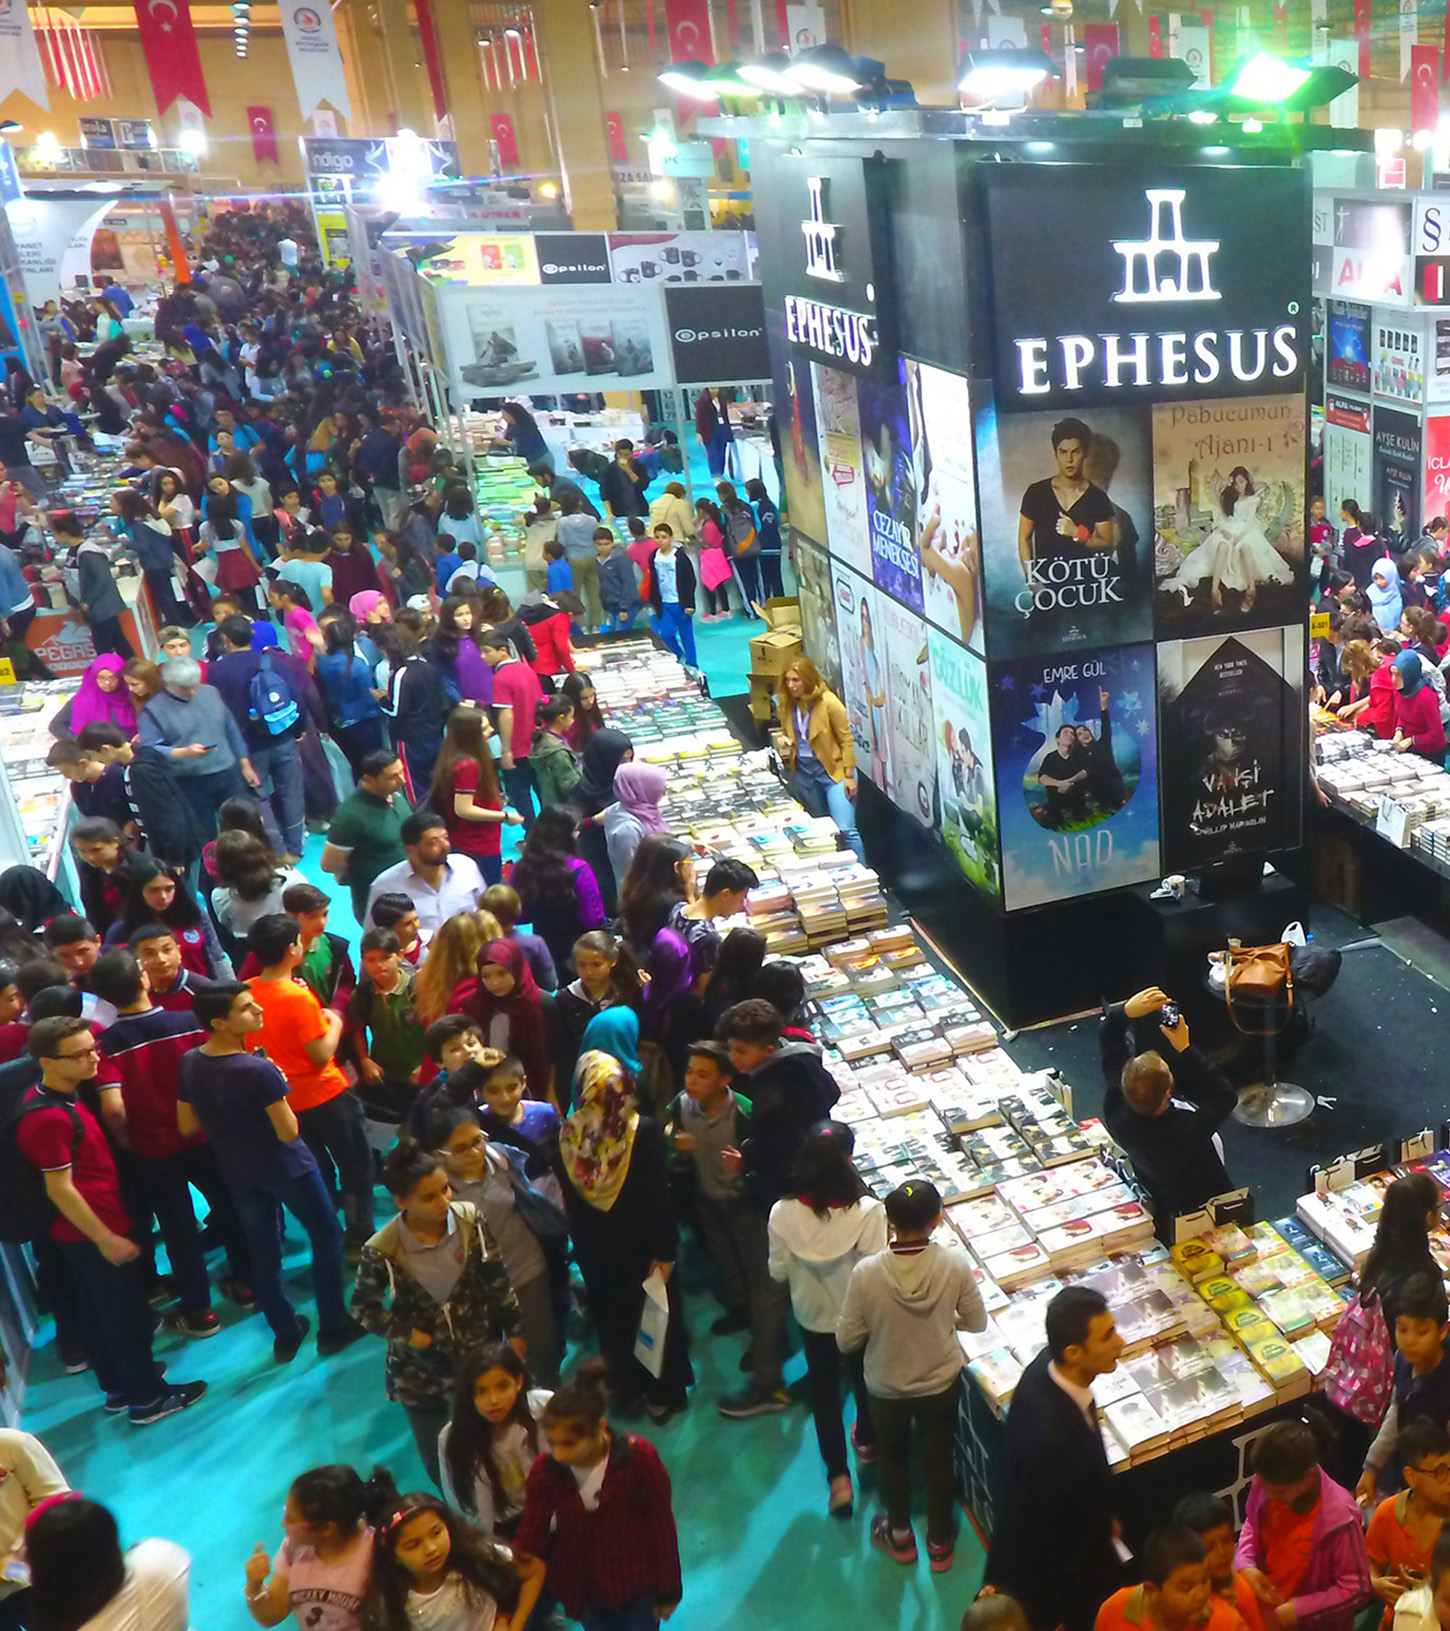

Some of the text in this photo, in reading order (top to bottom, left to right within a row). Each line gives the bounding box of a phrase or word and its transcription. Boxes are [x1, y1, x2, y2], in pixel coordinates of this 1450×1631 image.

[542, 263, 605, 274] epsilon
[675, 327, 761, 343] epsilon
[784, 295, 873, 367] EPHESUS
[1013, 325, 1299, 395] EPHESUS
[1171, 404, 1291, 429] Pabucumun
[1376, 431, 1420, 453] AYŞE KULİN
[1024, 552, 1112, 587] KÖTÜ
[1014, 576, 1124, 619] ÇOCUK
[34, 642, 98, 660] PEGAS
[1043, 660, 1106, 684] EMRE GÜL
